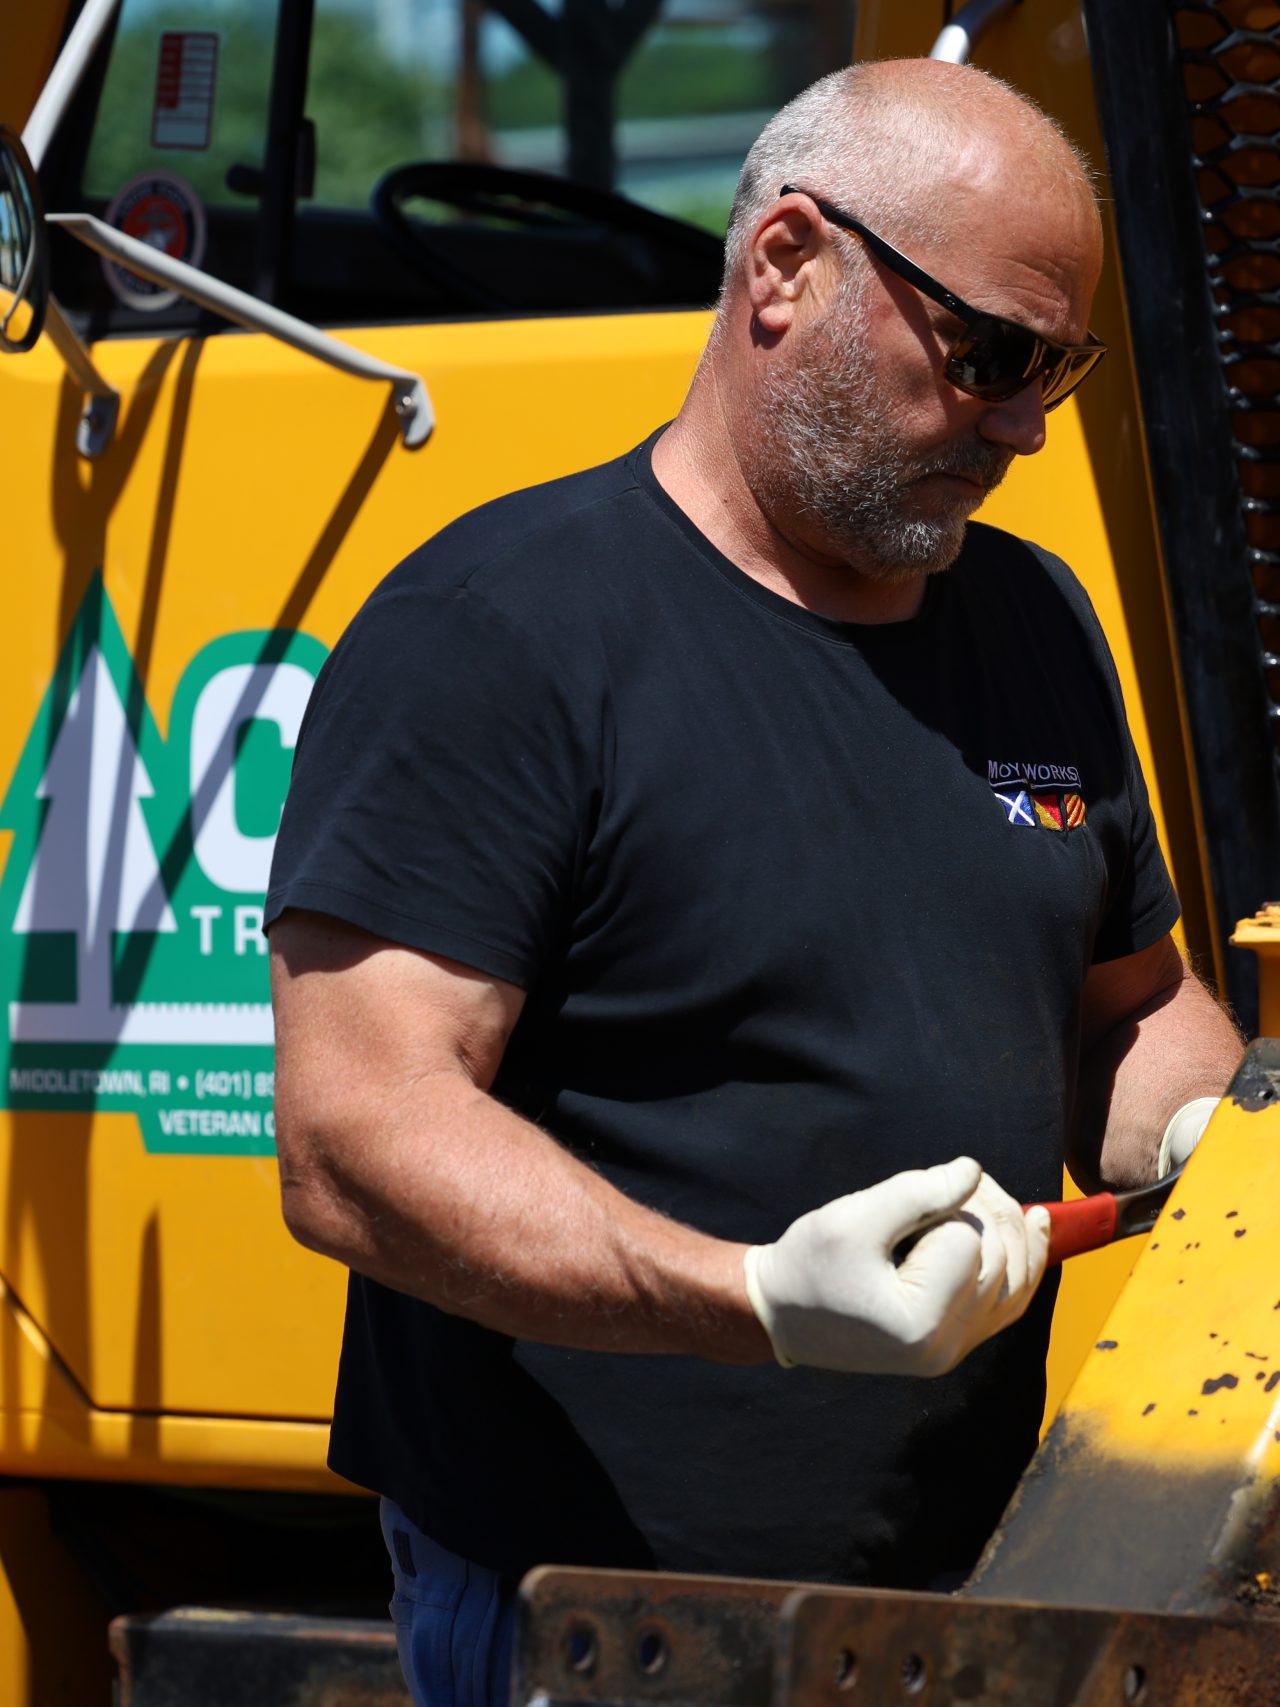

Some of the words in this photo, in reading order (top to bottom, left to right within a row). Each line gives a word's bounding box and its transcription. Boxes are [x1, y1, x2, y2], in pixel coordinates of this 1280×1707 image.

[988, 760, 1020, 779] MOY
[1022, 763, 1079, 781] WORKS
[150, 1071, 170, 1095] RI
[195, 1069, 251, 1100] (401)
[158, 1109, 261, 1136] VETERAN
